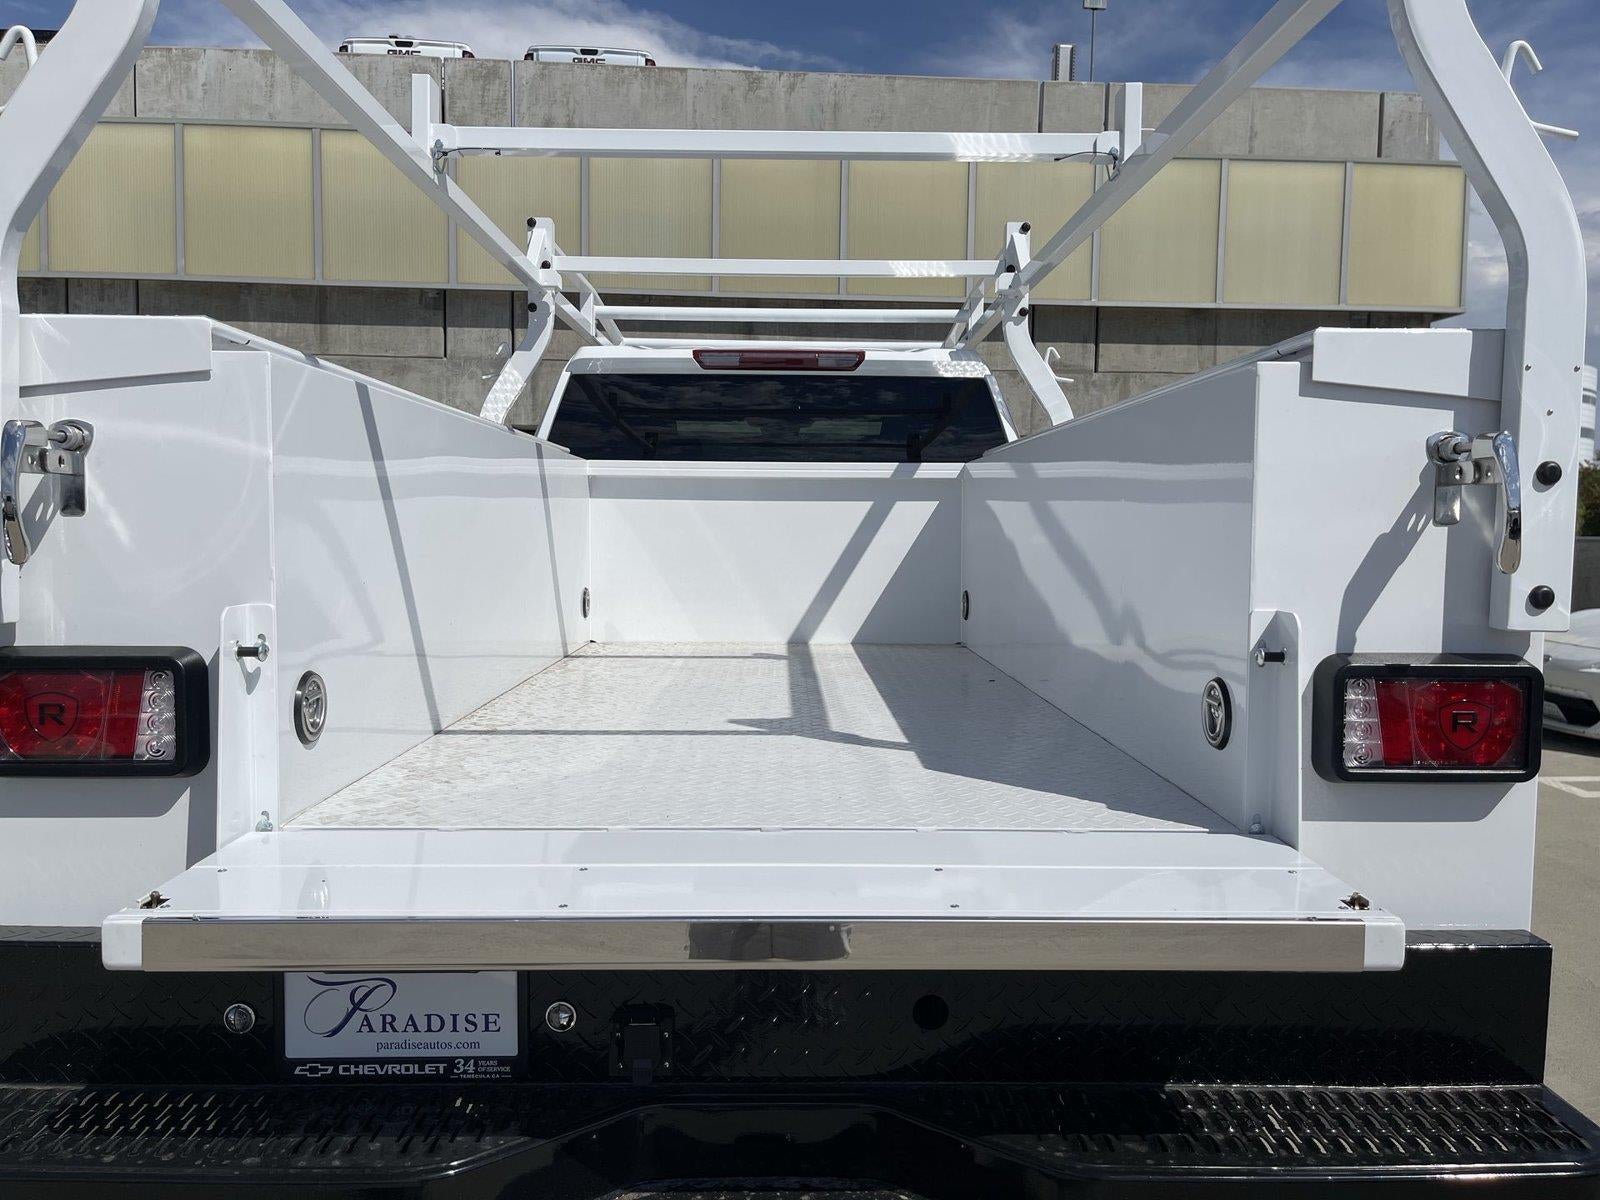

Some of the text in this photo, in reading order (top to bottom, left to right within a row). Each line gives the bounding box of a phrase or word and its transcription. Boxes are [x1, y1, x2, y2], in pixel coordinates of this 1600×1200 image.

[573, 57, 606, 65] GMC
[38, 703, 66, 726] R
[1451, 710, 1479, 734] R
[303, 974, 501, 1038] PARADISE
[376, 1038, 481, 1053] paradiseautos.com
[338, 1058, 476, 1075] CHEVROLET 34
